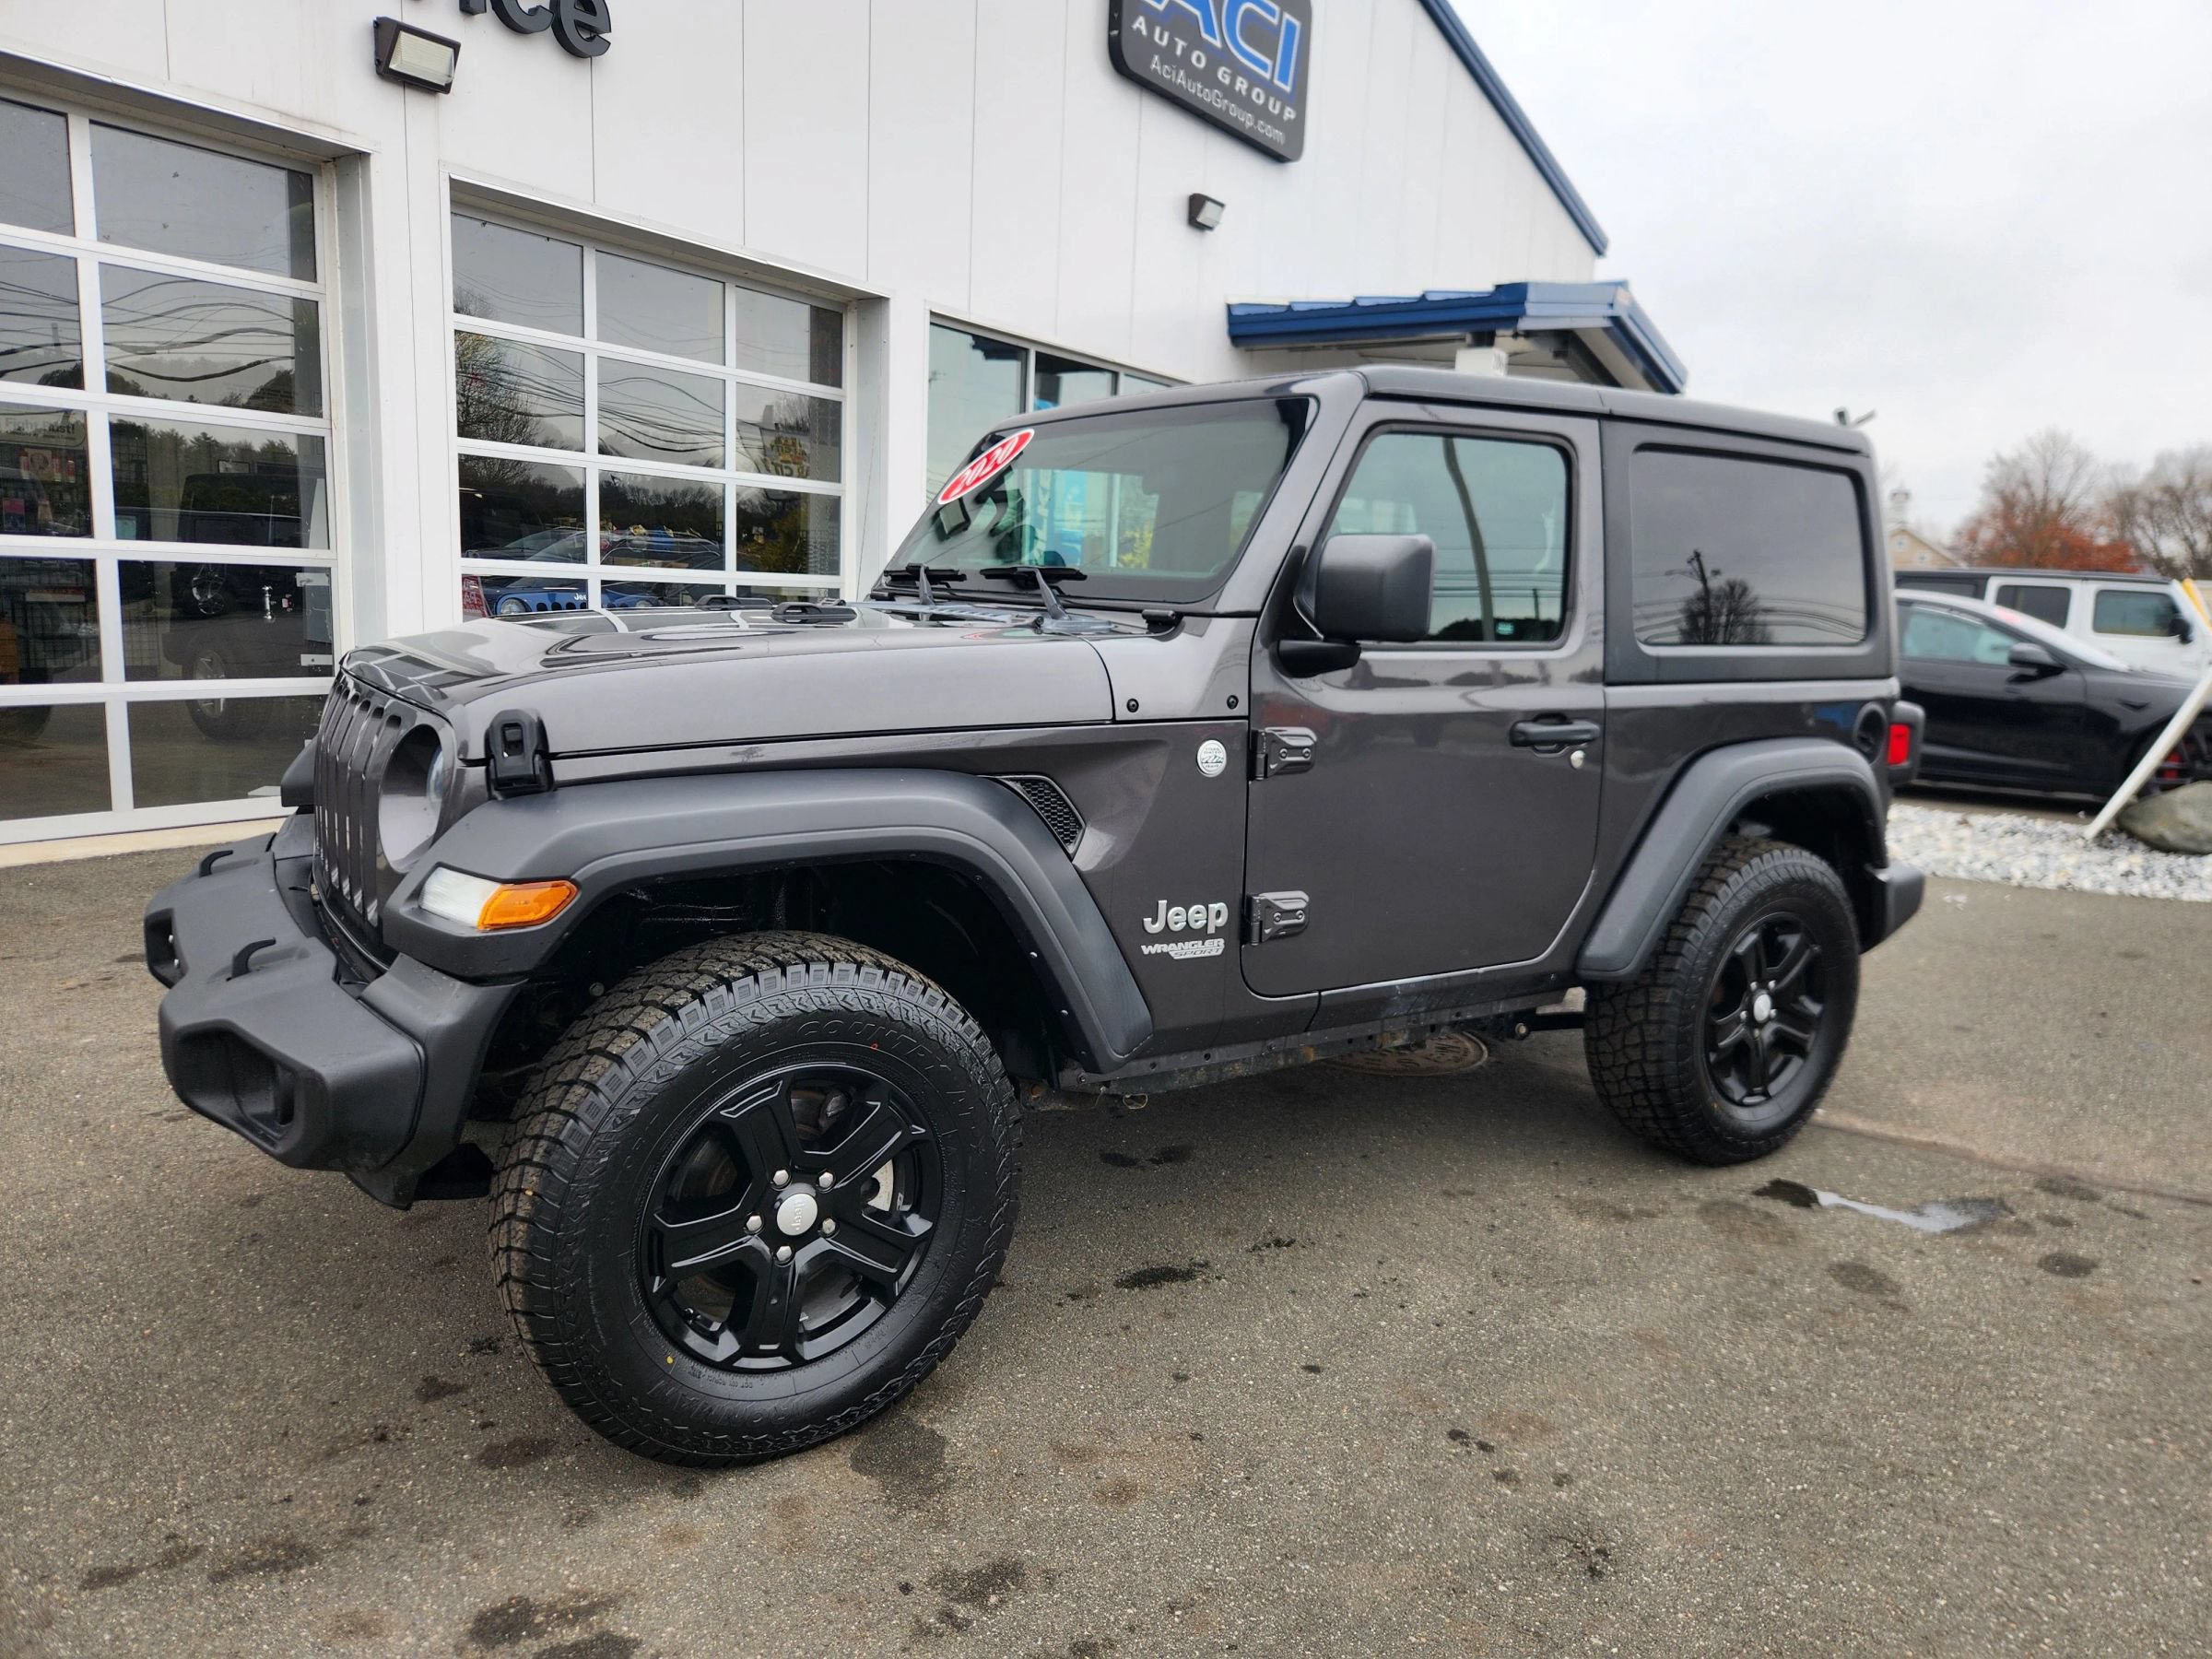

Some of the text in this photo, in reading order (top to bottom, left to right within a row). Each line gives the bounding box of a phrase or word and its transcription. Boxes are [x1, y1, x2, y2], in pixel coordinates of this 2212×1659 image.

[1132, 16, 1297, 122] AUTO GROUP
[1150, 54, 1287, 146] AciAutoGroup.com
[948, 435, 1019, 499] 2020
[1143, 900, 1229, 935] Jeep
[1141, 938, 1225, 955] WRANGLER
[1171, 947, 1222, 958] SPORT
